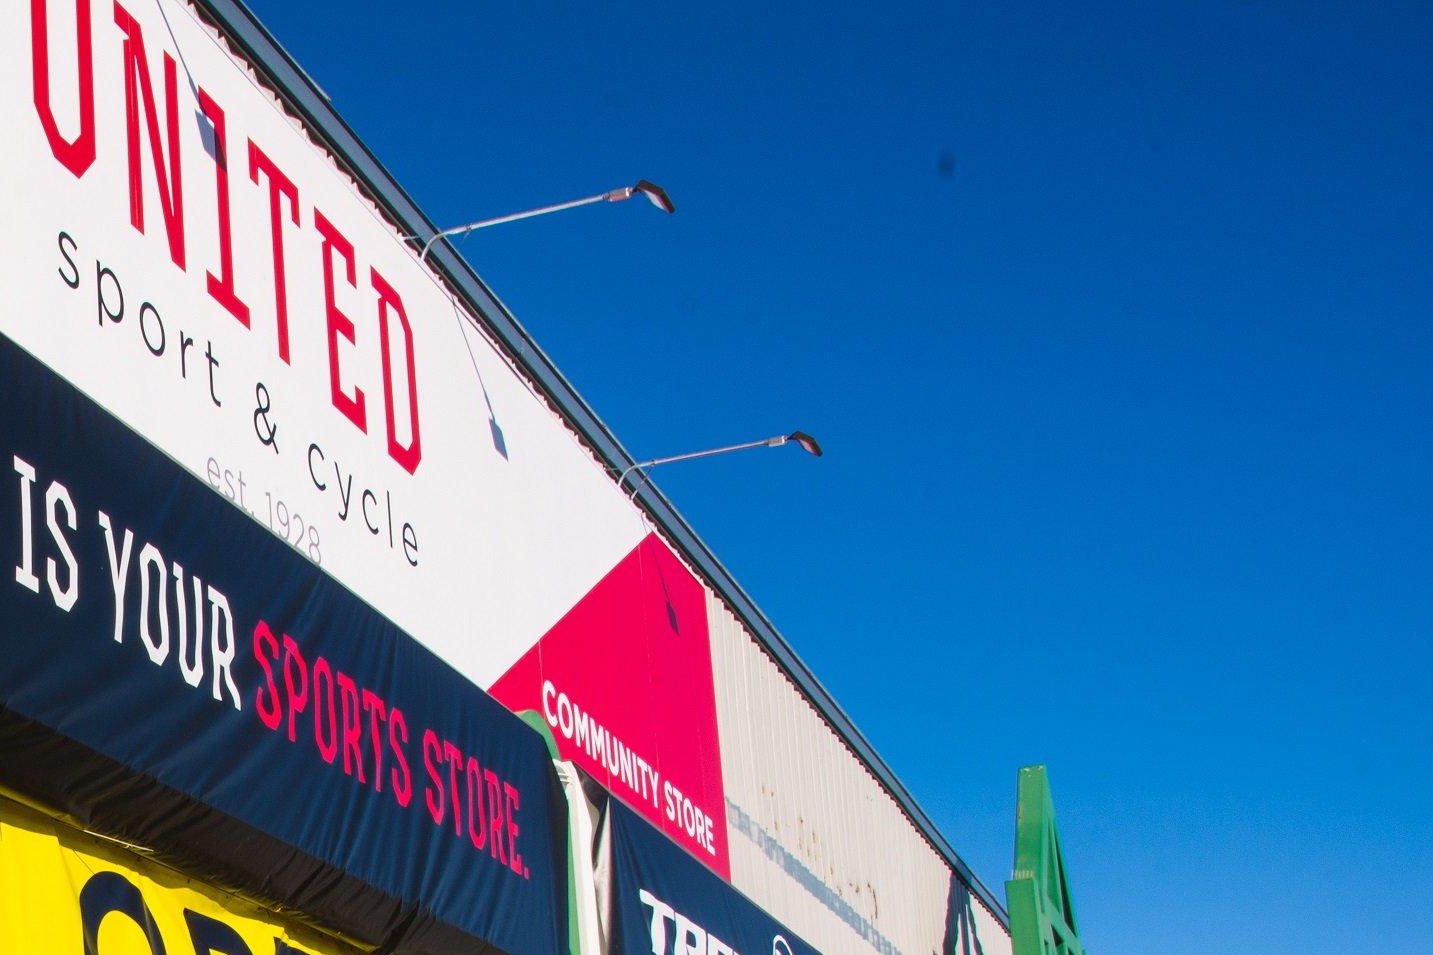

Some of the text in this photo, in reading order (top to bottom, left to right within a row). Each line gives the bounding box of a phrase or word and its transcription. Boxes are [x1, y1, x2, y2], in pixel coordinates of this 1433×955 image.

[31, 0, 423, 475] UNITED
[58, 231, 421, 567] sport & cycle
[13, 454, 79, 613] IS
[98, 510, 242, 712] YOUR
[252, 620, 413, 808] SPORTS
[423, 729, 531, 880] STORE.
[206, 456, 322, 567] est. 1928
[542, 680, 716, 856] COMMUNITY STORE
